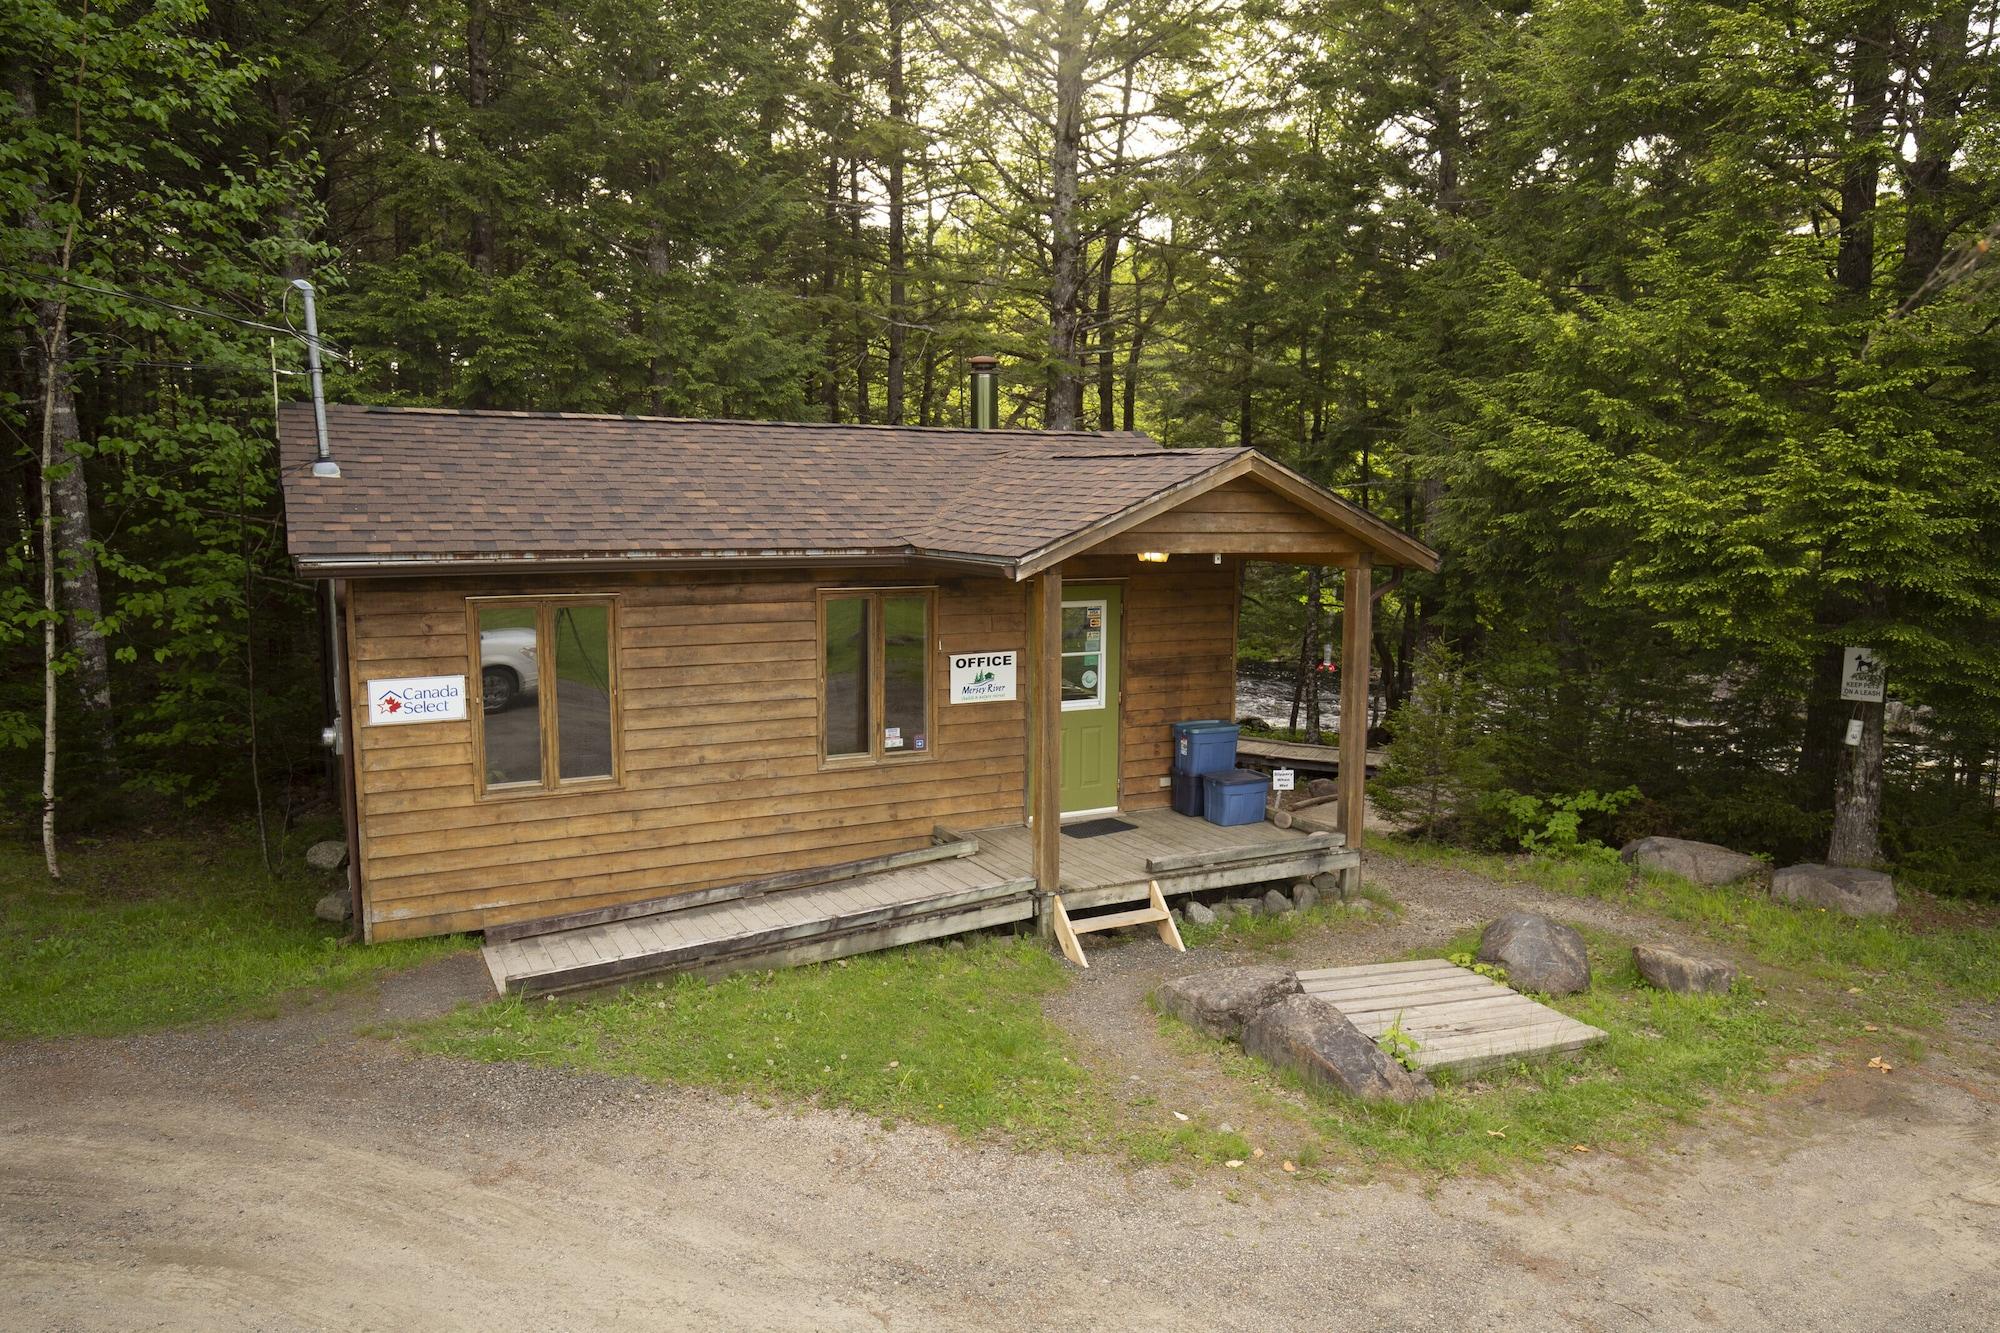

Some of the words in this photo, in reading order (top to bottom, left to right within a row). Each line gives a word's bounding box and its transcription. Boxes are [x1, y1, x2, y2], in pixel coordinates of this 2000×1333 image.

[955, 655, 1012, 669] OFFICE
[402, 684, 459, 700] Canada
[962, 685, 987, 695] Mersey
[987, 683, 1006, 693] River
[403, 700, 449, 715] Select
